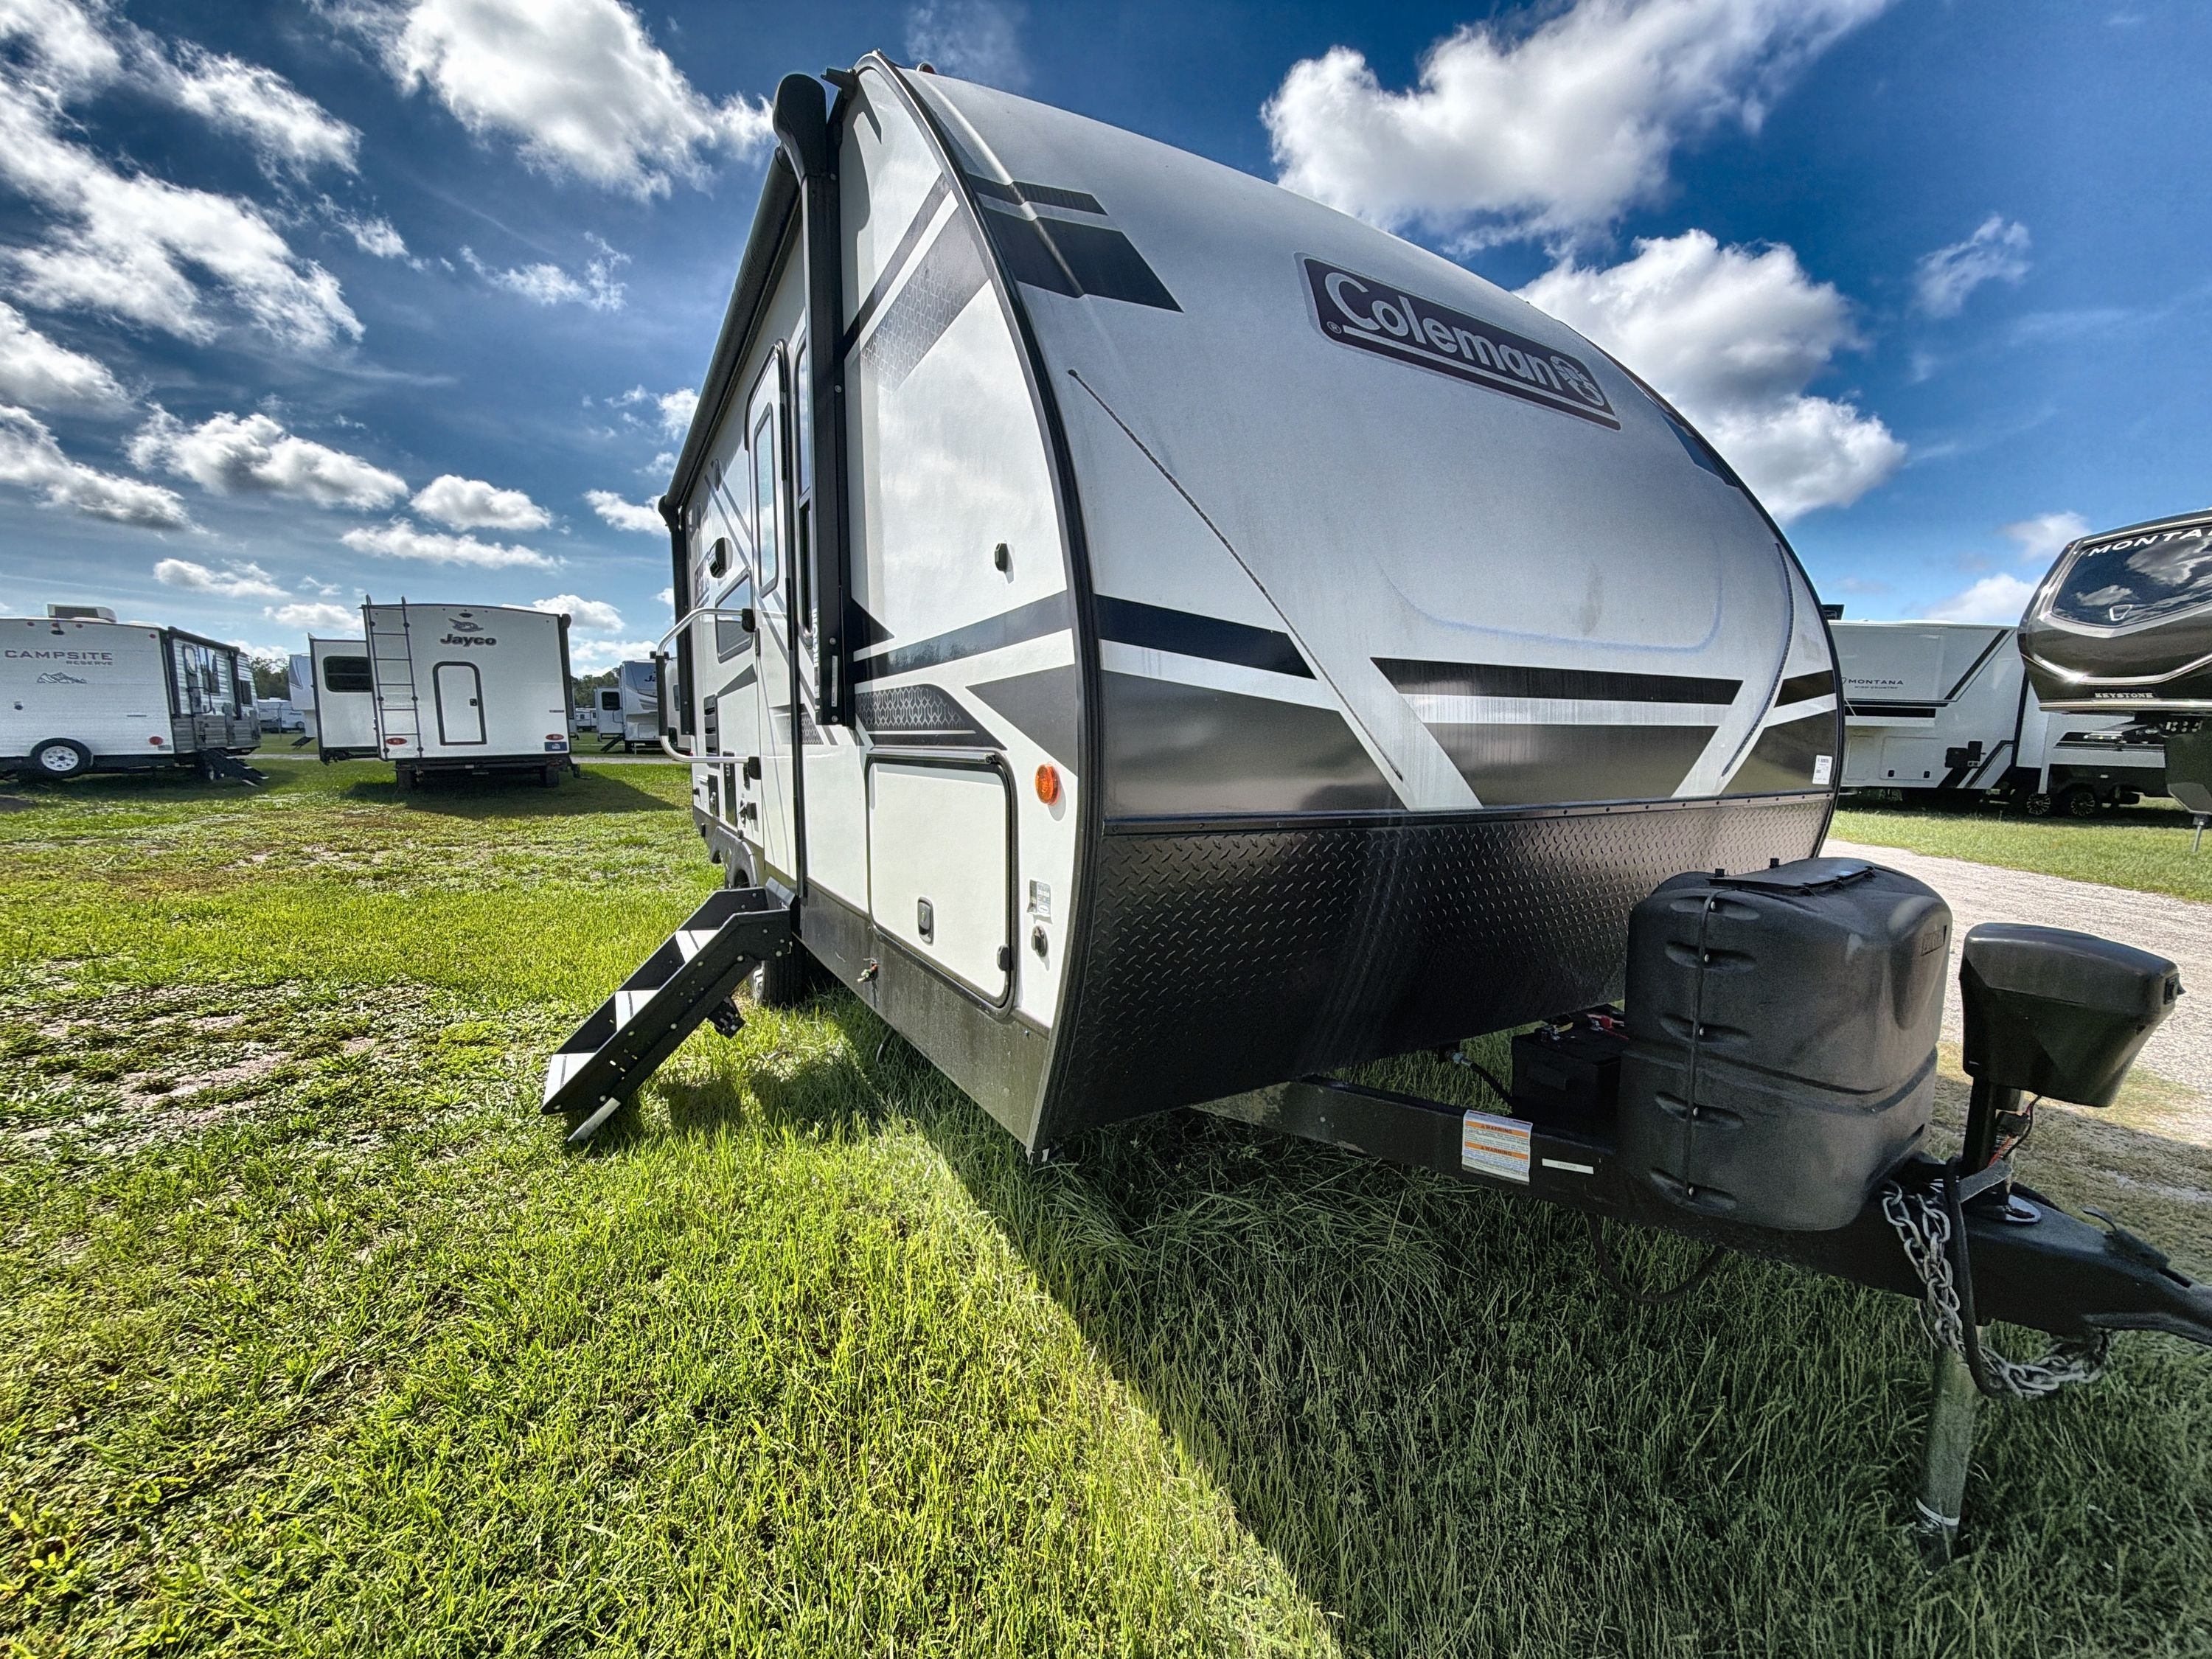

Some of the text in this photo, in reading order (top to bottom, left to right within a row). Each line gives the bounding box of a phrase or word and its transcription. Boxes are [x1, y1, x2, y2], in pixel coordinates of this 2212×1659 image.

[1324, 272, 1564, 392] Coleman
[2087, 528, 2212, 557] MONTA
[439, 633, 497, 647] Jayco
[4, 650, 113, 661] CAMPSITE
[1485, 1124, 1512, 1134] WARNING
[1485, 1146, 1512, 1156] WARNING
